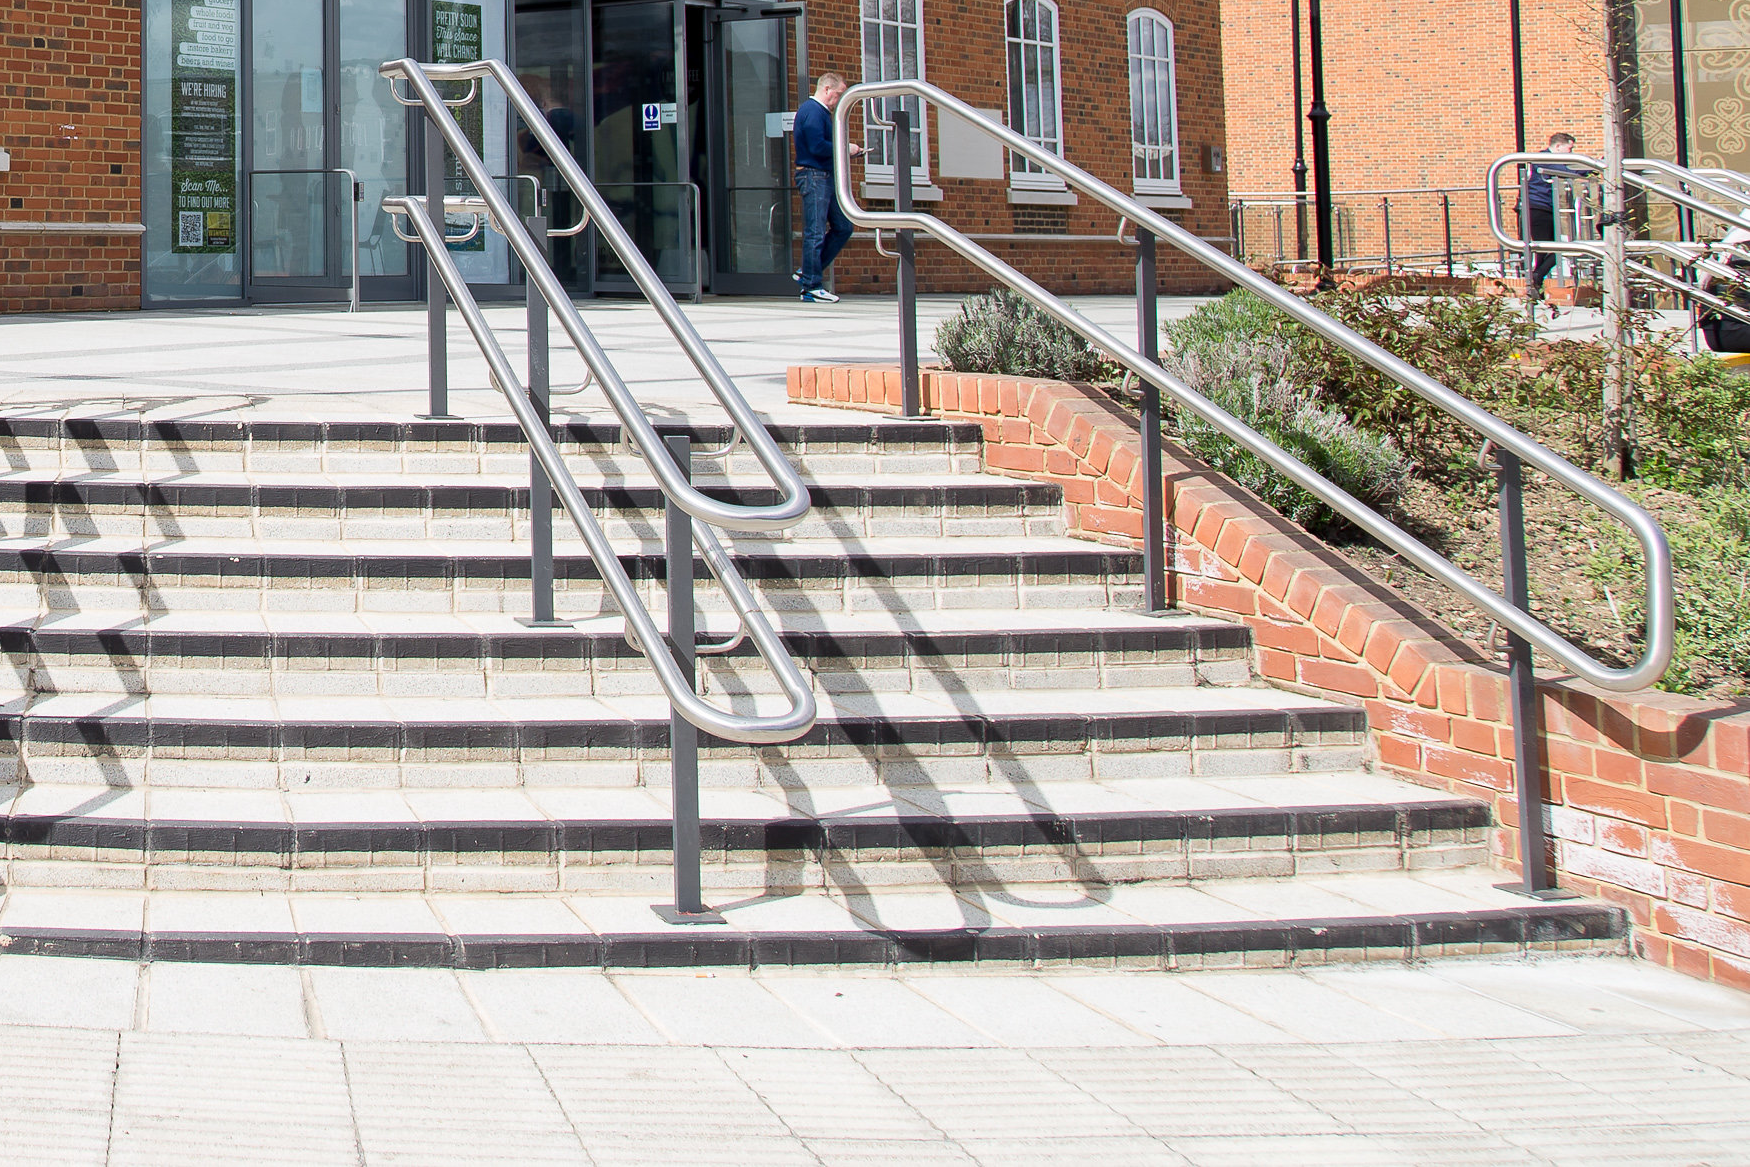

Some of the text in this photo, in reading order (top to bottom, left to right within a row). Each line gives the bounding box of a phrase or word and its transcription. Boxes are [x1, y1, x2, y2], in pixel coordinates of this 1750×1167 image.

[193, 20, 234, 32] fruit and veg
[435, 10, 478, 28] PRETTY SOON
[201, 32, 217, 41] food
[217, 34, 224, 42] to
[436, 25, 478, 43] This Space
[187, 44, 234, 55] instore bakery
[436, 42, 478, 60] WILL CHANGE
[181, 57, 234, 68] beers and wines
[181, 81, 227, 98] WE'RE HIRING
[180, 178, 228, 194] Scan Me...
[178, 195, 230, 209] TO FIND OUT MORE
